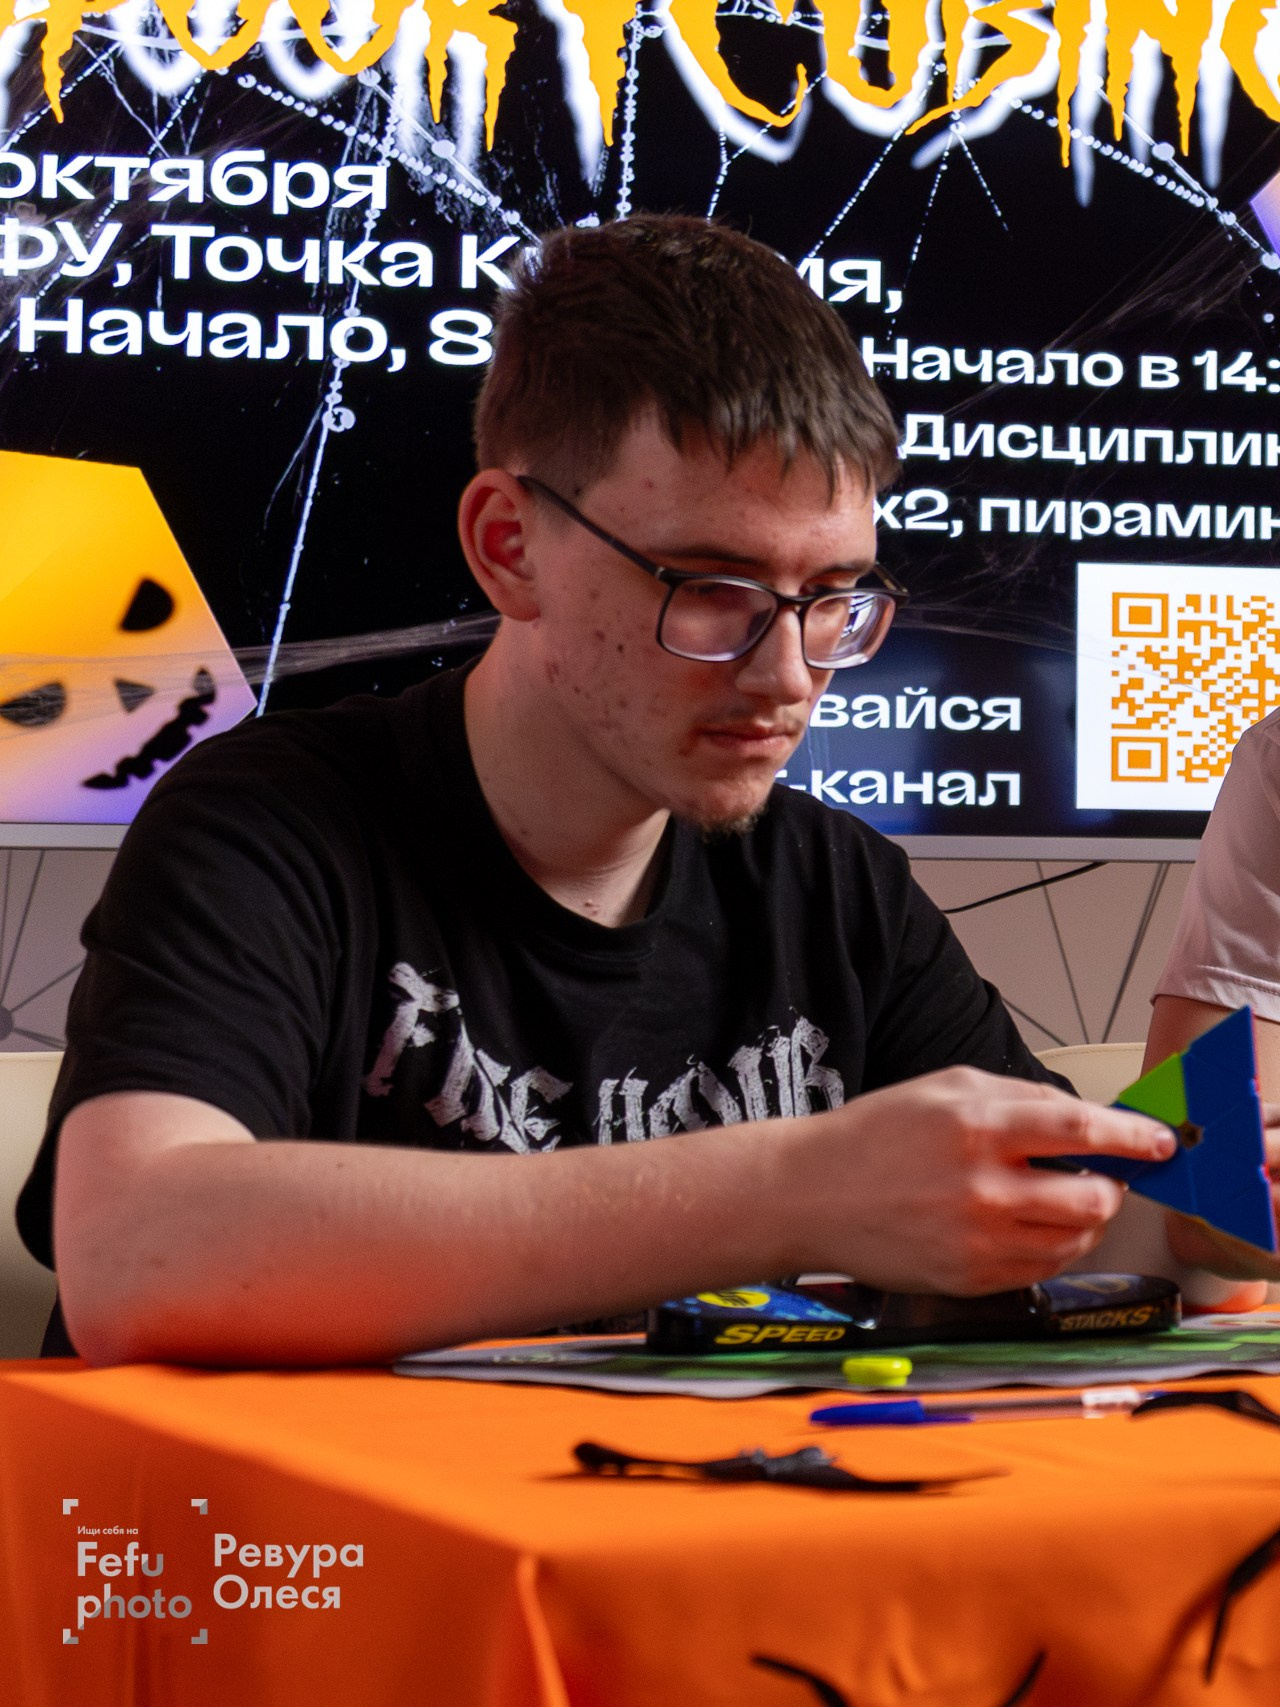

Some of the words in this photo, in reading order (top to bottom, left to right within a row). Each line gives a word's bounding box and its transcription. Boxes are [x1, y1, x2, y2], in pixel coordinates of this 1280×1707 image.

[0, 148, 388, 215] октября
[150, 222, 434, 289] Точка
[18, 297, 406, 373] Начало,
[862, 337, 1124, 388] Начало
[1140, 355, 1180, 389] в
[809, 686, 1021, 731] вайся
[714, 1323, 846, 1345] SPEED
[1059, 1306, 1153, 1332] STACKS
